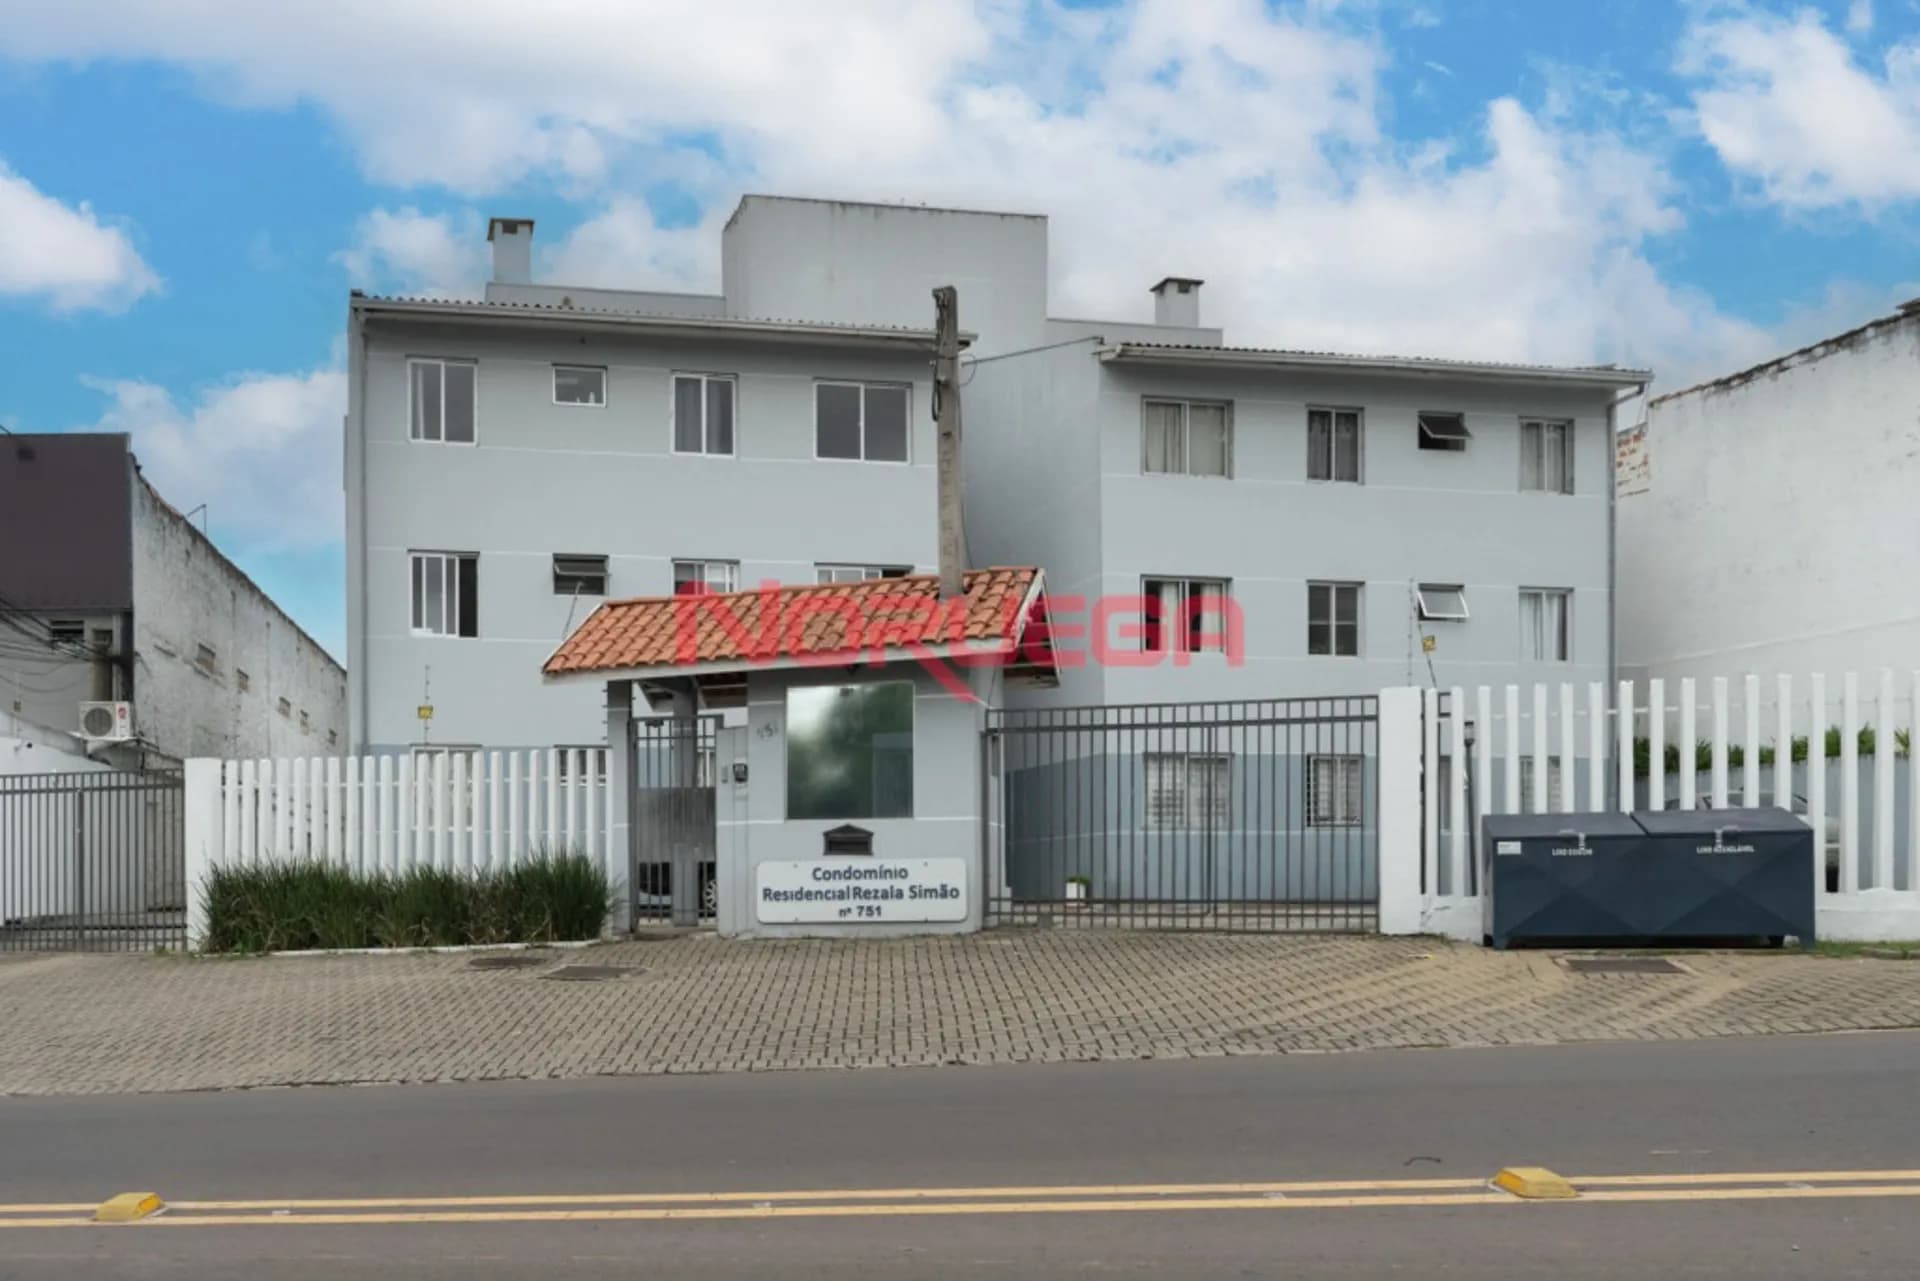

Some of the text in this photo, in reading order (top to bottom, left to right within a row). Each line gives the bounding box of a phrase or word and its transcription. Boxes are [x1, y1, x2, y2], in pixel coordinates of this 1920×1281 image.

[812, 866, 909, 881] Condomínio
[762, 886, 850, 901] Residencial
[908, 883, 960, 899] Simão
[857, 905, 882, 917] 751
